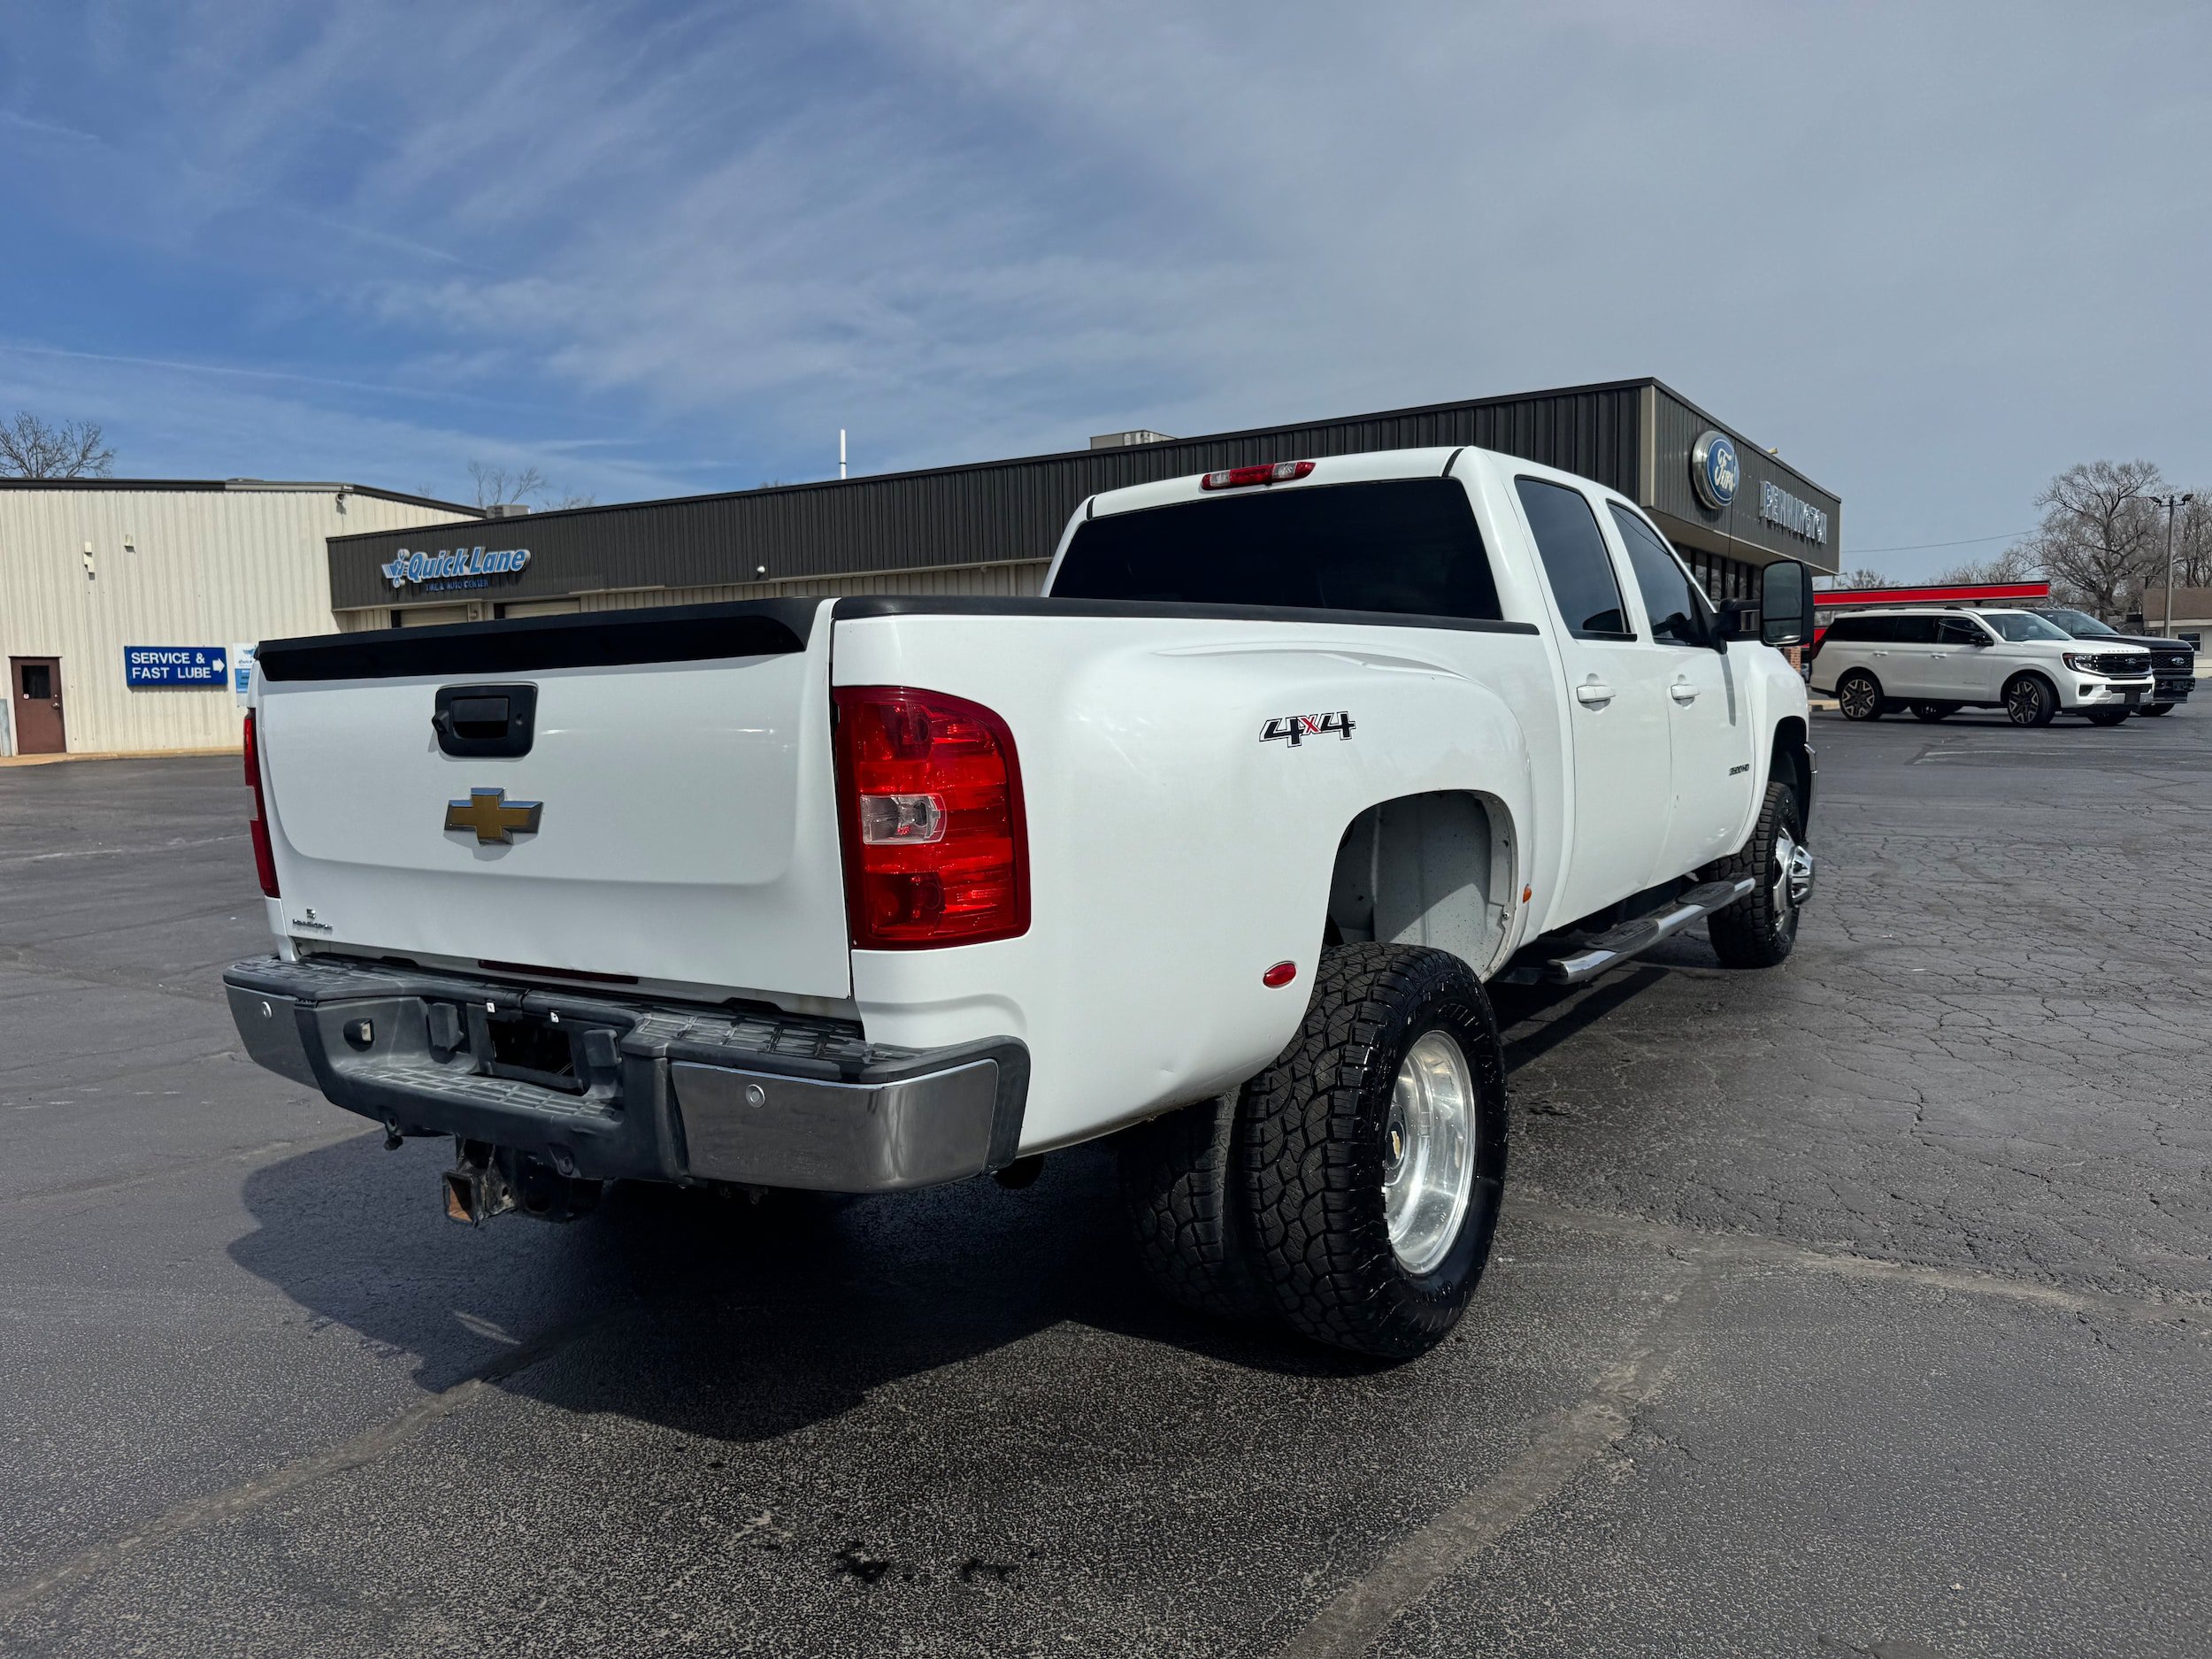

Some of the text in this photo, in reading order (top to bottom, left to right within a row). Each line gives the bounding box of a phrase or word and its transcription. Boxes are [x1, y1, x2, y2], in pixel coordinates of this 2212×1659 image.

[1714, 448, 1737, 493] Ford
[407, 545, 531, 584] Quick Lane
[131, 652, 206, 664] SERVICE &
[132, 666, 212, 680] FAST LUBE
